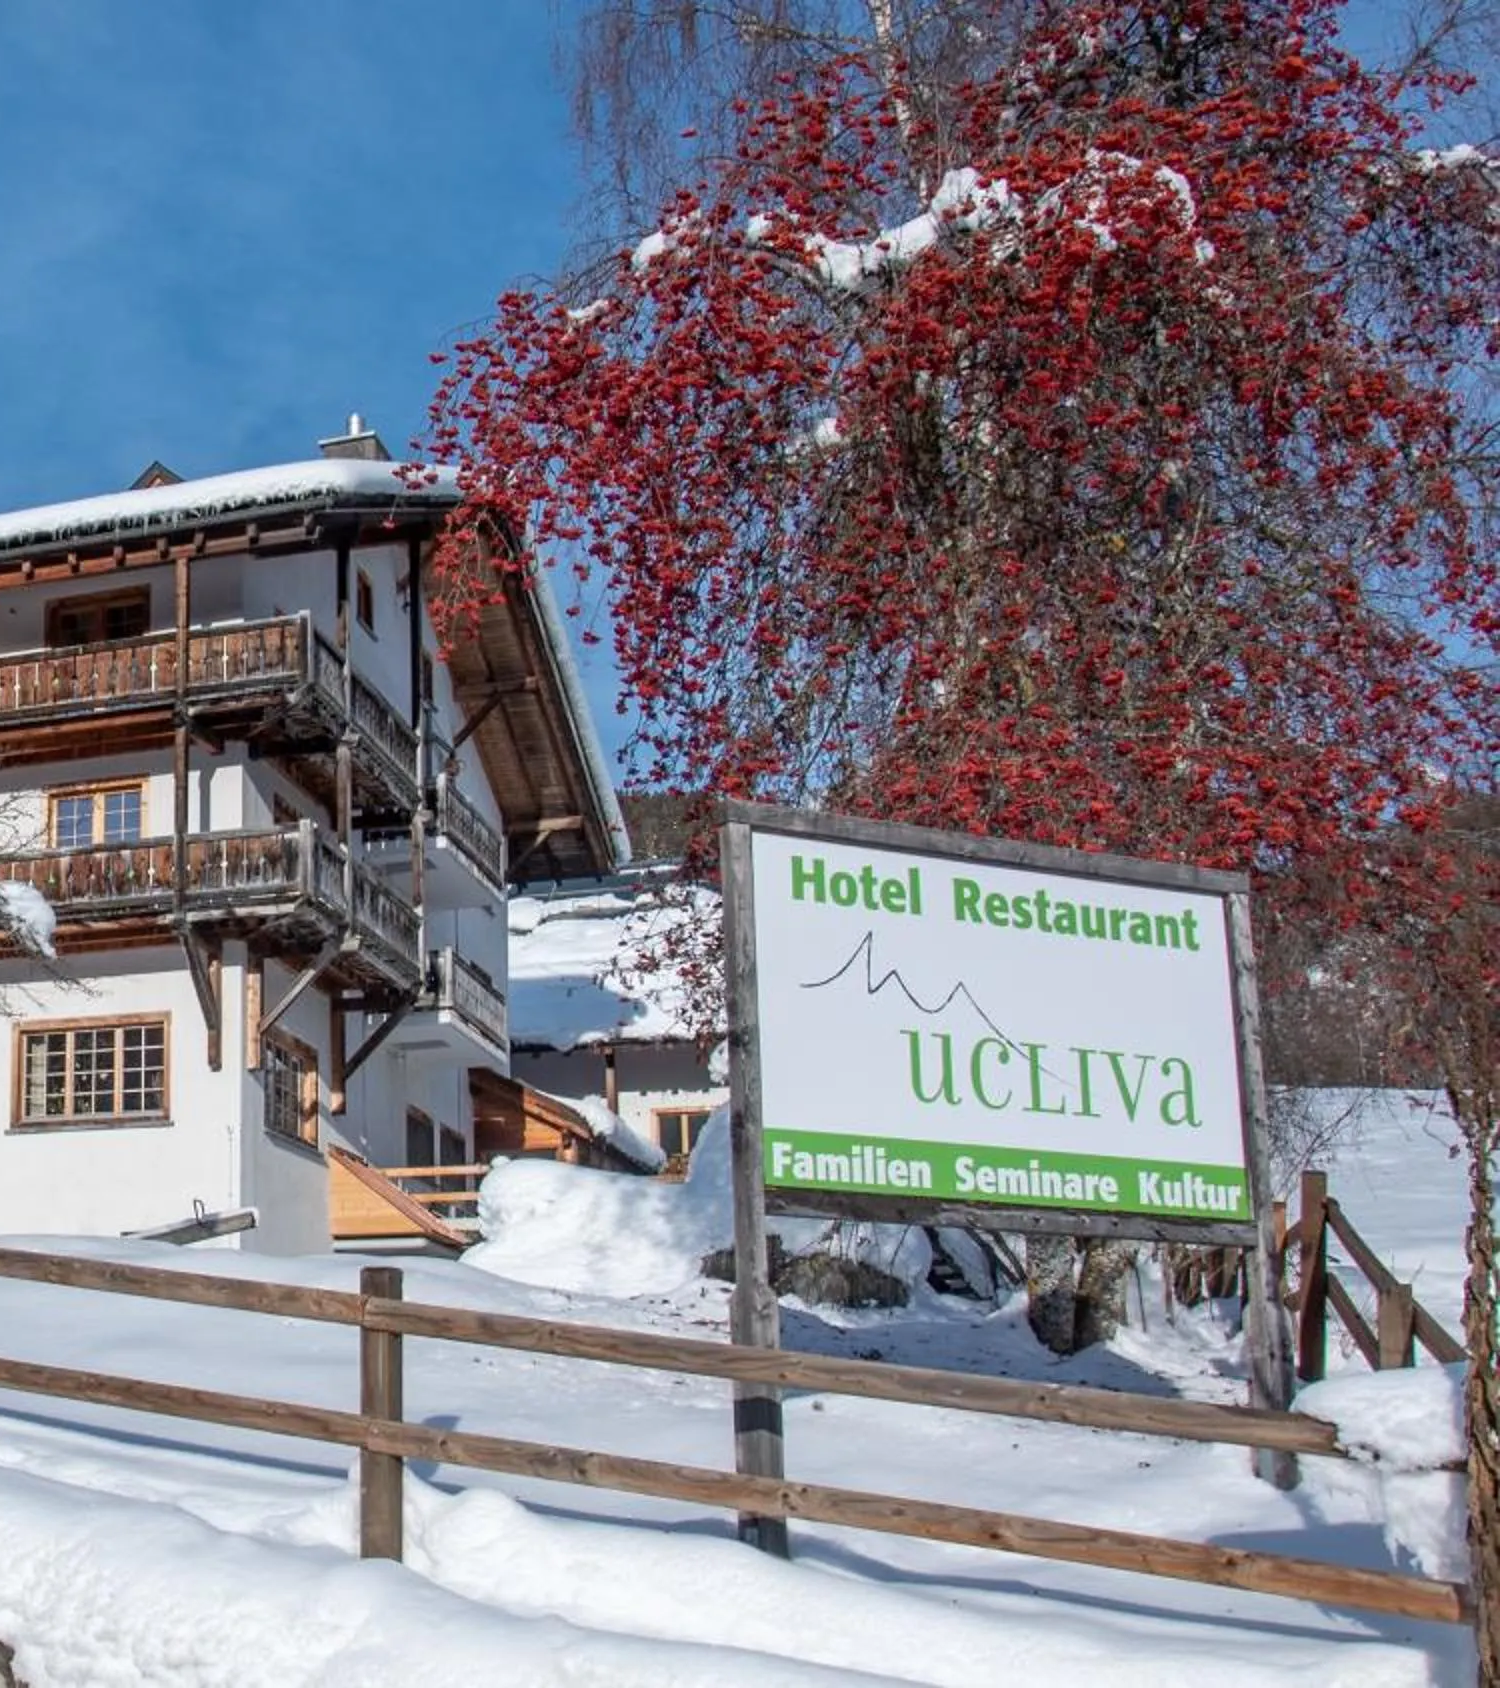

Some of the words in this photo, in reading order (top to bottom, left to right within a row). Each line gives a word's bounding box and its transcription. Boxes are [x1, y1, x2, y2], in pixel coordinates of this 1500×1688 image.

[790, 856, 922, 915] Hotel
[953, 878, 1200, 951] Restaurant
[772, 1142, 932, 1189] Familien
[955, 1157, 1118, 1203] Seminare
[1138, 1171, 1242, 1212] Kultur
